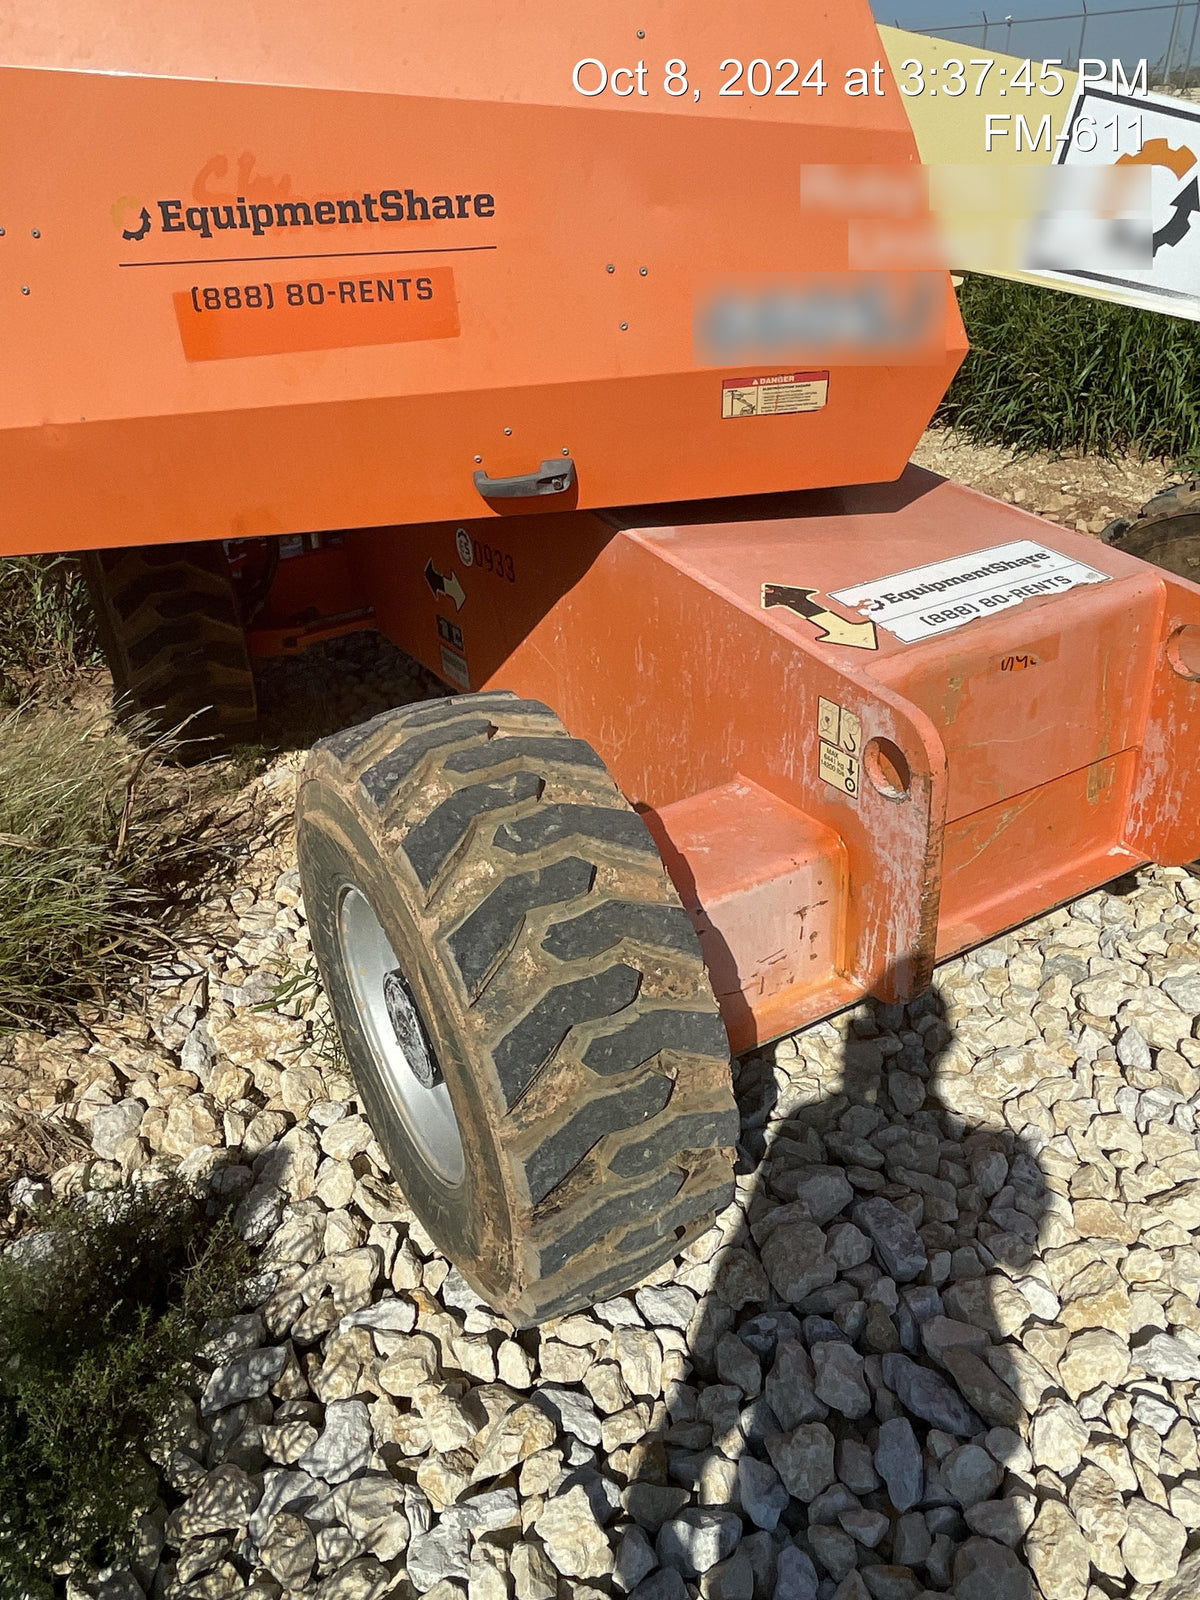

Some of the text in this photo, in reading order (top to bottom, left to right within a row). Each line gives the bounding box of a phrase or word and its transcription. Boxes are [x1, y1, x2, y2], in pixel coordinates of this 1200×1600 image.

[157, 189, 496, 239] EquipmentShare
[191, 277, 433, 313] (888) 80-RENTS
[759, 375, 795, 385] DANGER
[473, 540, 515, 583] 0933
[880, 551, 1051, 605] EquipmentShare
[919, 575, 1073, 626] (888) 80-RENTS
